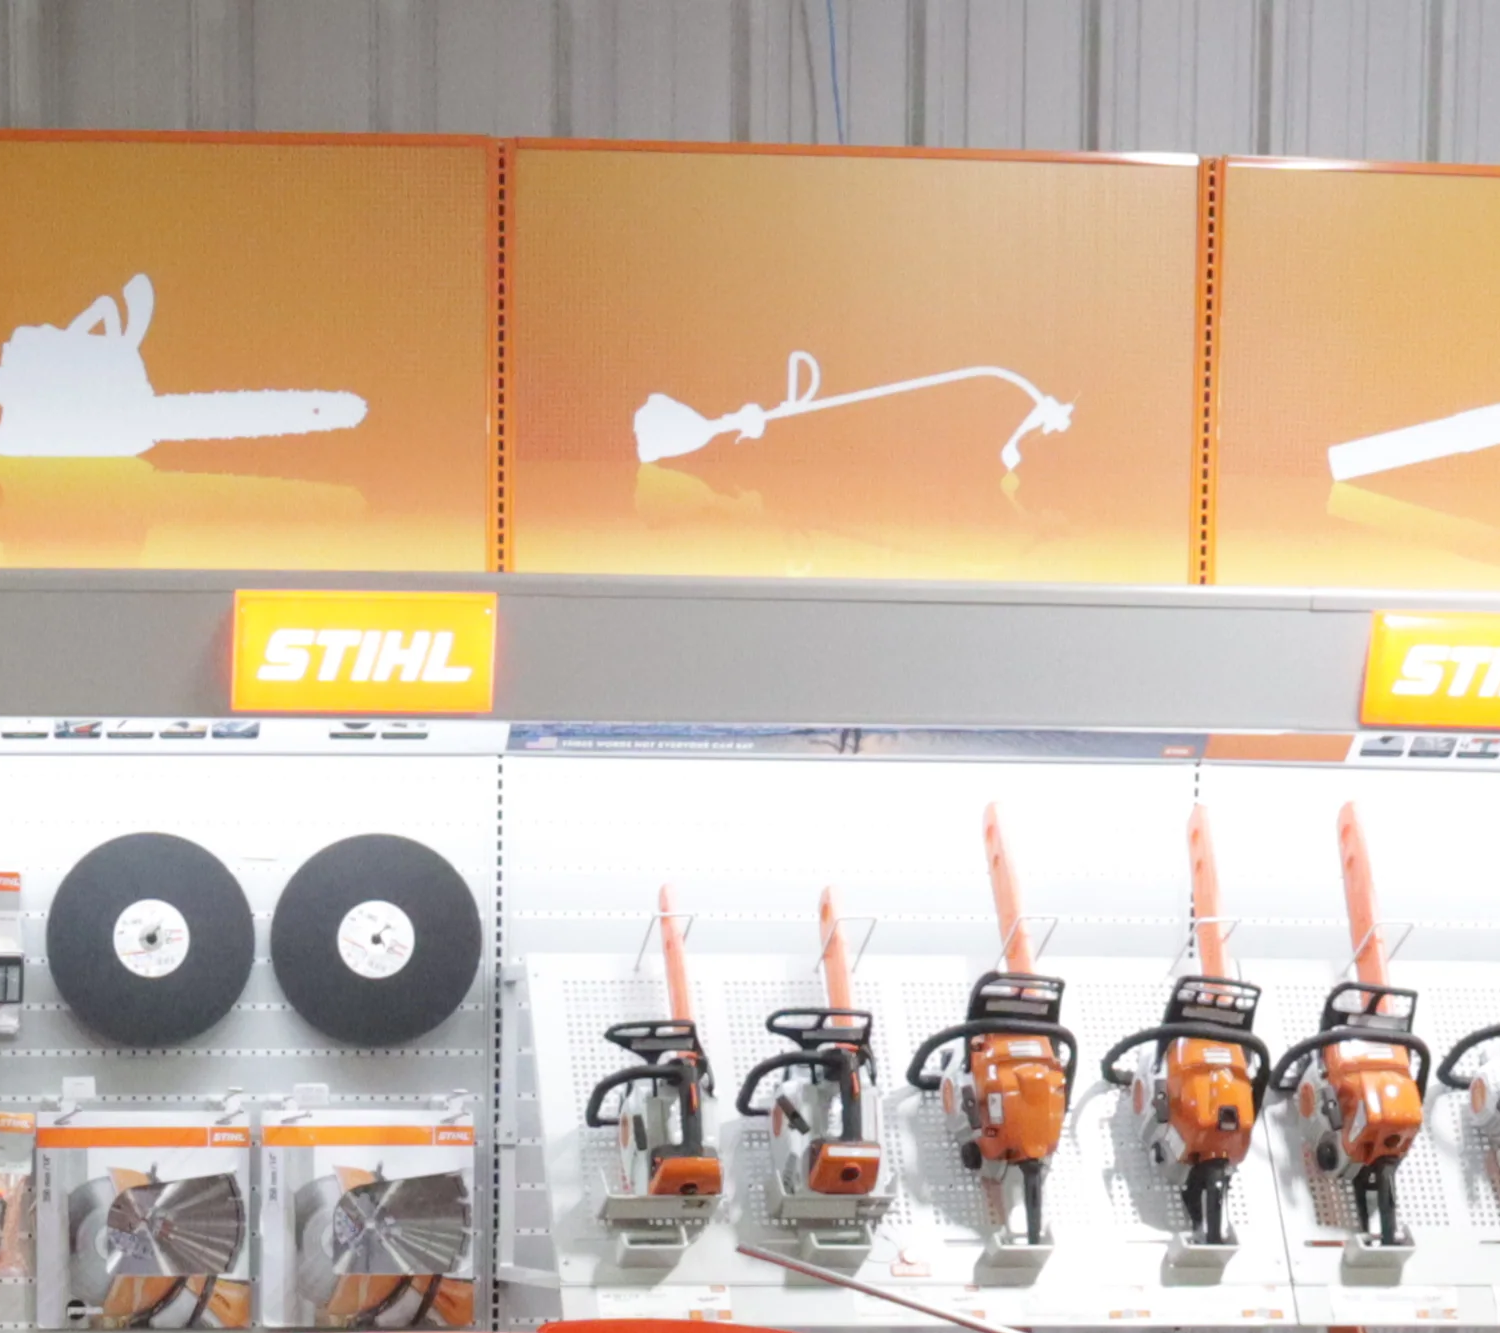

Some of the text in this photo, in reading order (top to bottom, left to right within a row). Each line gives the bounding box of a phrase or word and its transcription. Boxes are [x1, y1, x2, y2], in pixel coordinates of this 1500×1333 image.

[255, 628, 473, 683] STIHL
[0, 1117, 31, 1129] STIHL
[213, 1132, 246, 1142] STIHL
[438, 1131, 470, 1141] STIHL
